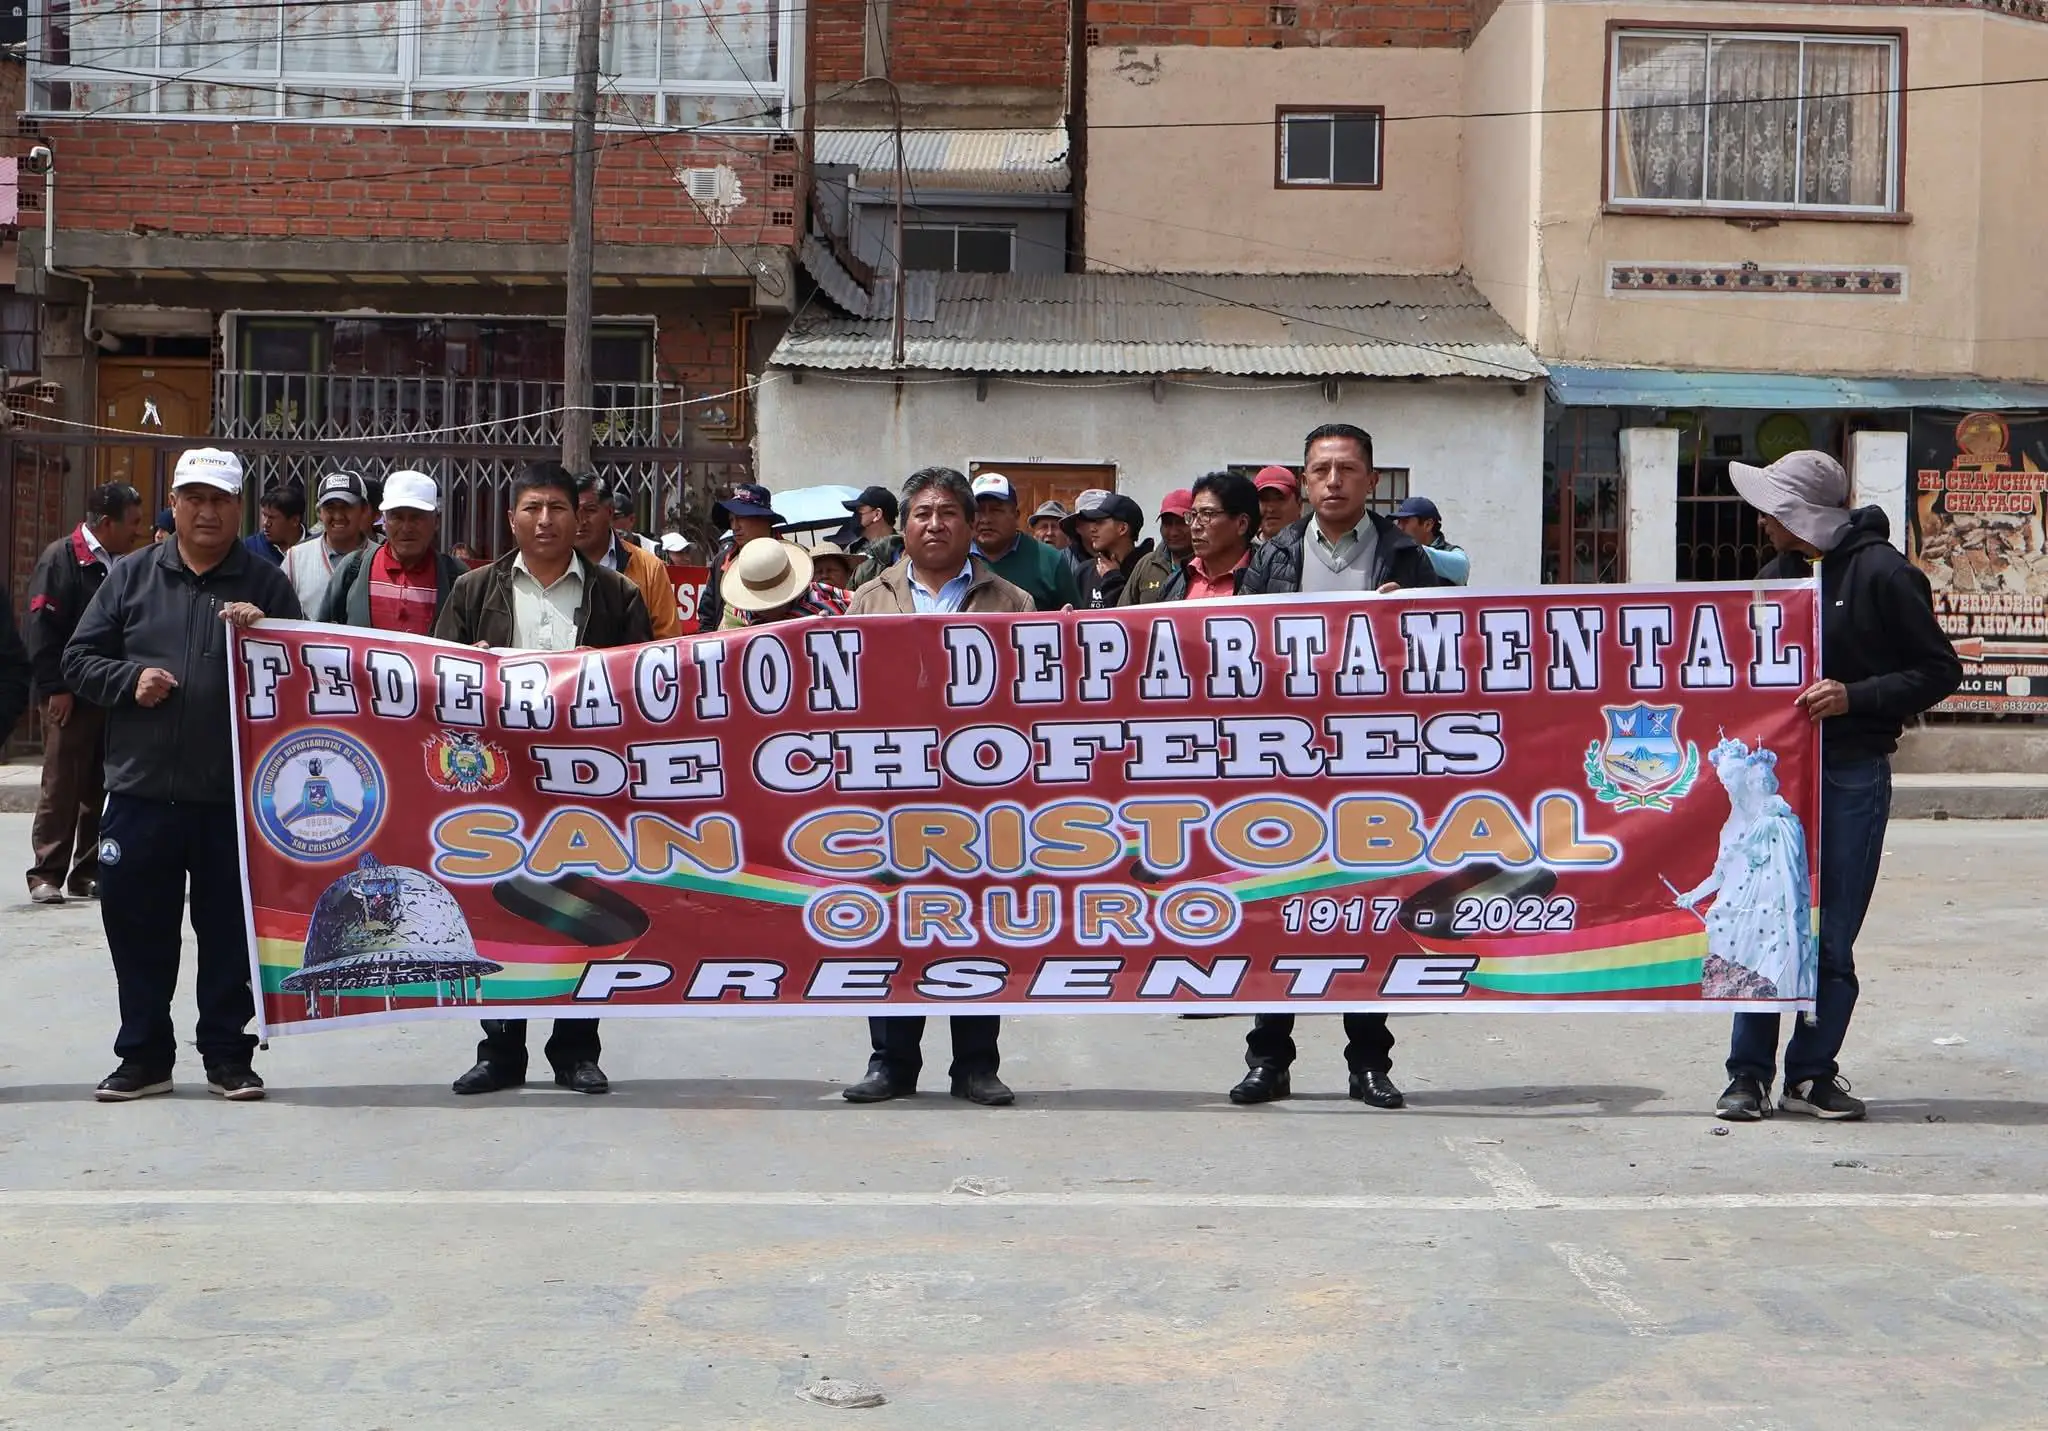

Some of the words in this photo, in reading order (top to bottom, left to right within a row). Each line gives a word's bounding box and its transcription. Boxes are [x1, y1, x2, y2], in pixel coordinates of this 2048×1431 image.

[1918, 470, 1944, 491] EL
[1945, 471, 2048, 492] CHANCHIT
[1944, 492, 2034, 513] CHAPACO
[1937, 614, 1968, 635] BOR
[1970, 614, 2048, 636] AHUMAD
[242, 629, 862, 729] FEDERACION
[944, 604, 1803, 708] DEPARTAMENTAL
[1982, 663, 2016, 676] DOMINGO
[2016, 663, 2023, 676] Y
[1956, 681, 1981, 692] ALO
[1985, 681, 2003, 692] EN
[530, 737, 725, 800] DE
[753, 712, 1505, 792] CHOFERES
[431, 805, 742, 877] SAN
[786, 792, 1619, 876] CRISTOBAL
[806, 883, 1240, 944] ORURO
[1282, 898, 1399, 932] 1917
[1452, 897, 1577, 932] 2022
[573, 954, 1481, 1002] PRESENTE
